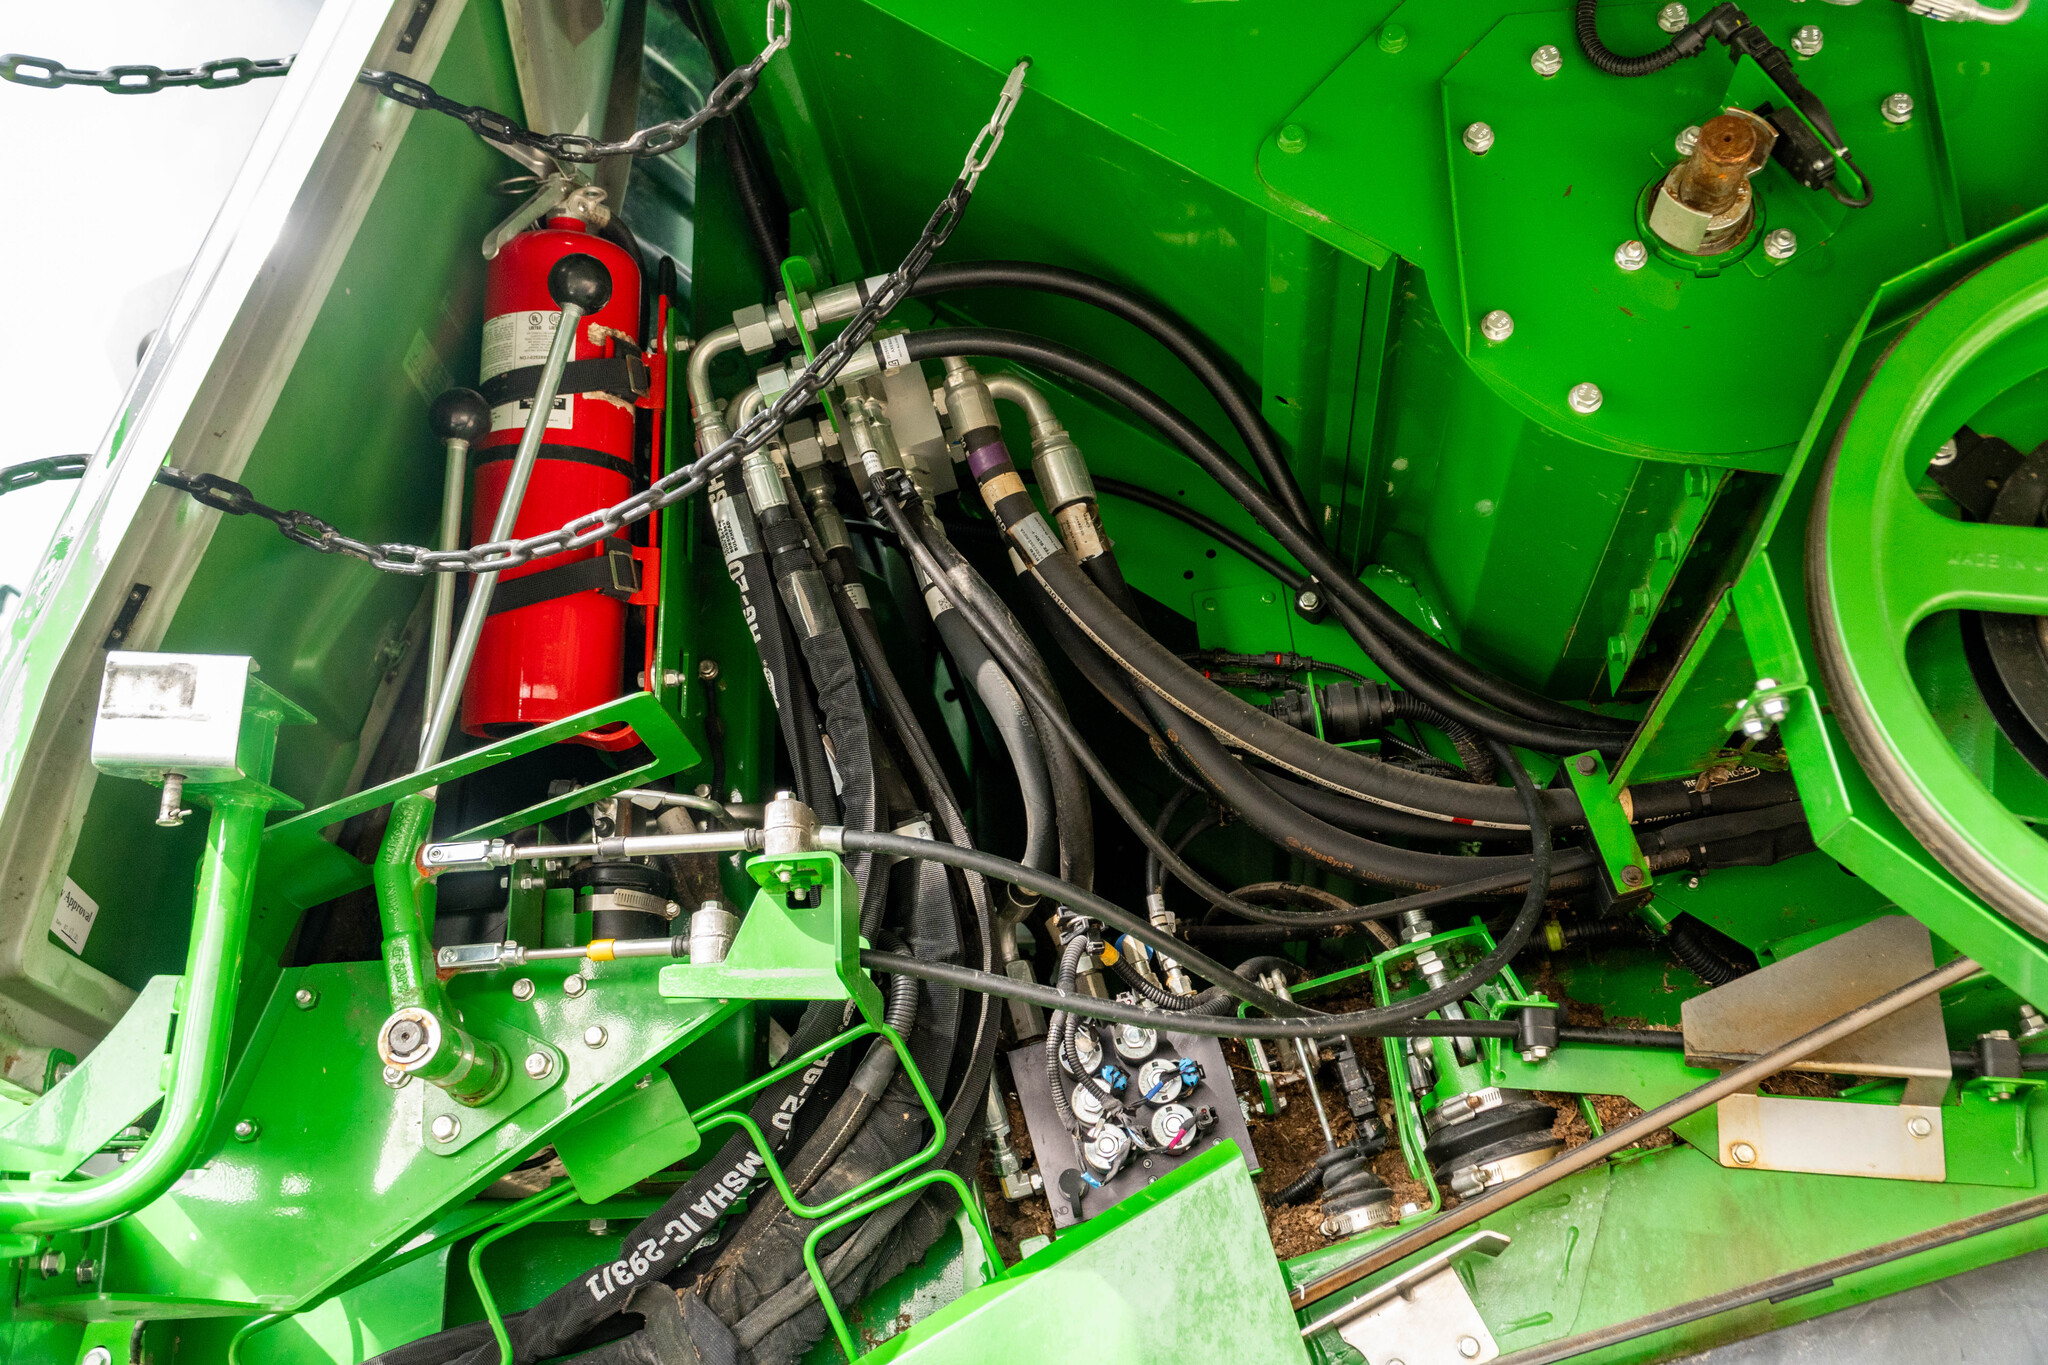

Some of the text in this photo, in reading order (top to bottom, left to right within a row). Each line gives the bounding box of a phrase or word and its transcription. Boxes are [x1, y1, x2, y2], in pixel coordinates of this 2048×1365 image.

[64, 891, 93, 923] Approval
[586, 1151, 765, 1301] MSHA IC-293/1
